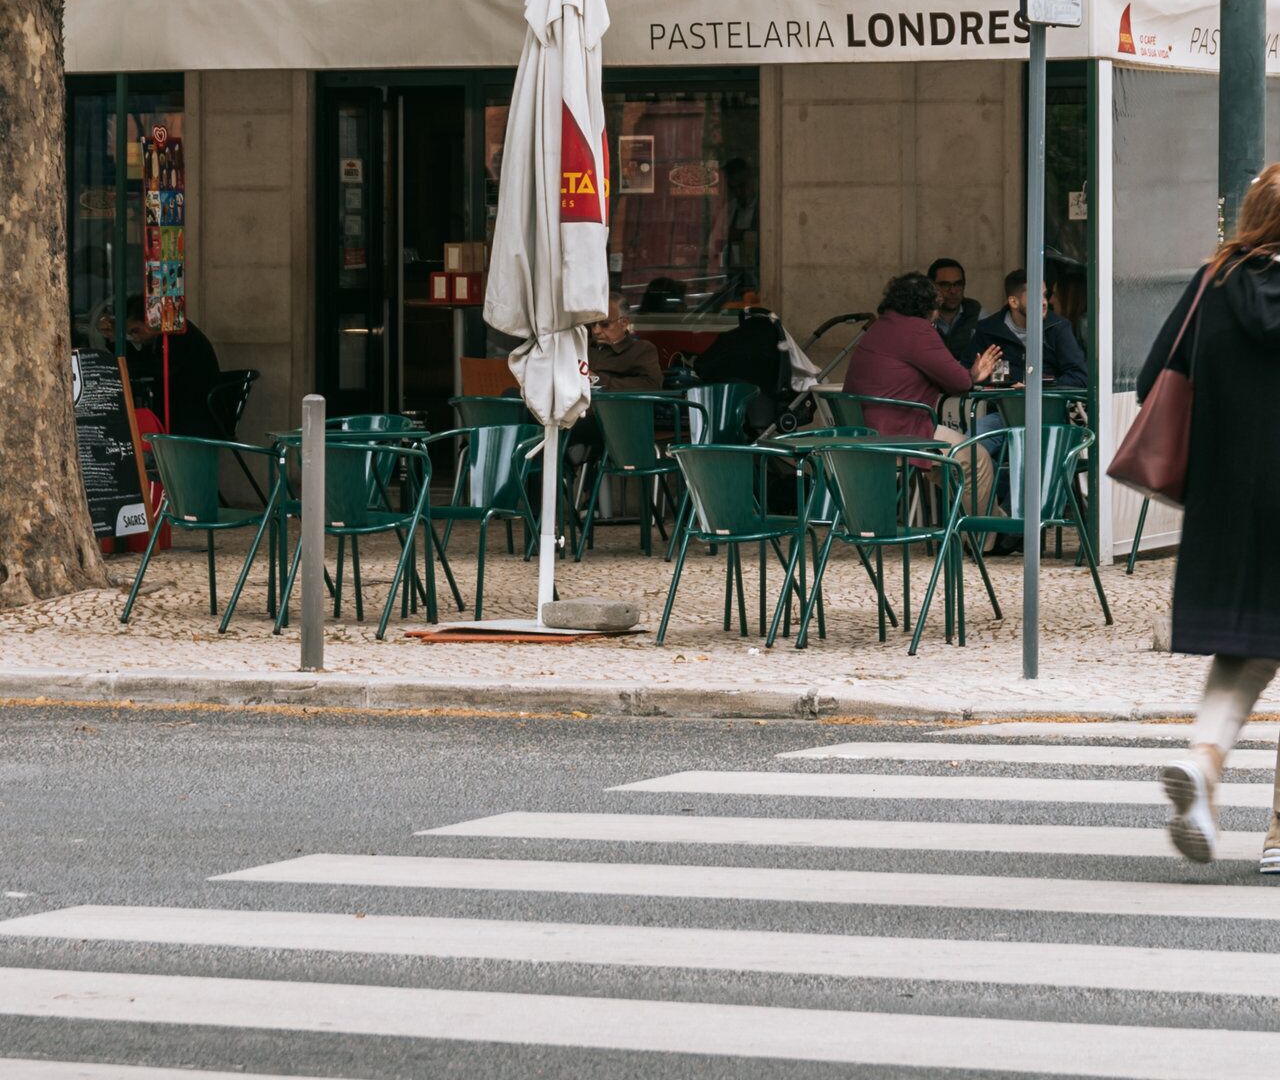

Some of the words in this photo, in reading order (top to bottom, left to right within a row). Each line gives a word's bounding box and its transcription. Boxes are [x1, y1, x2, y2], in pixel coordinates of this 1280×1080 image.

[649, 20, 835, 50] PASTELARIA
[846, 9, 1031, 48] LONDRES
[122, 512, 146, 528] SAGRES
